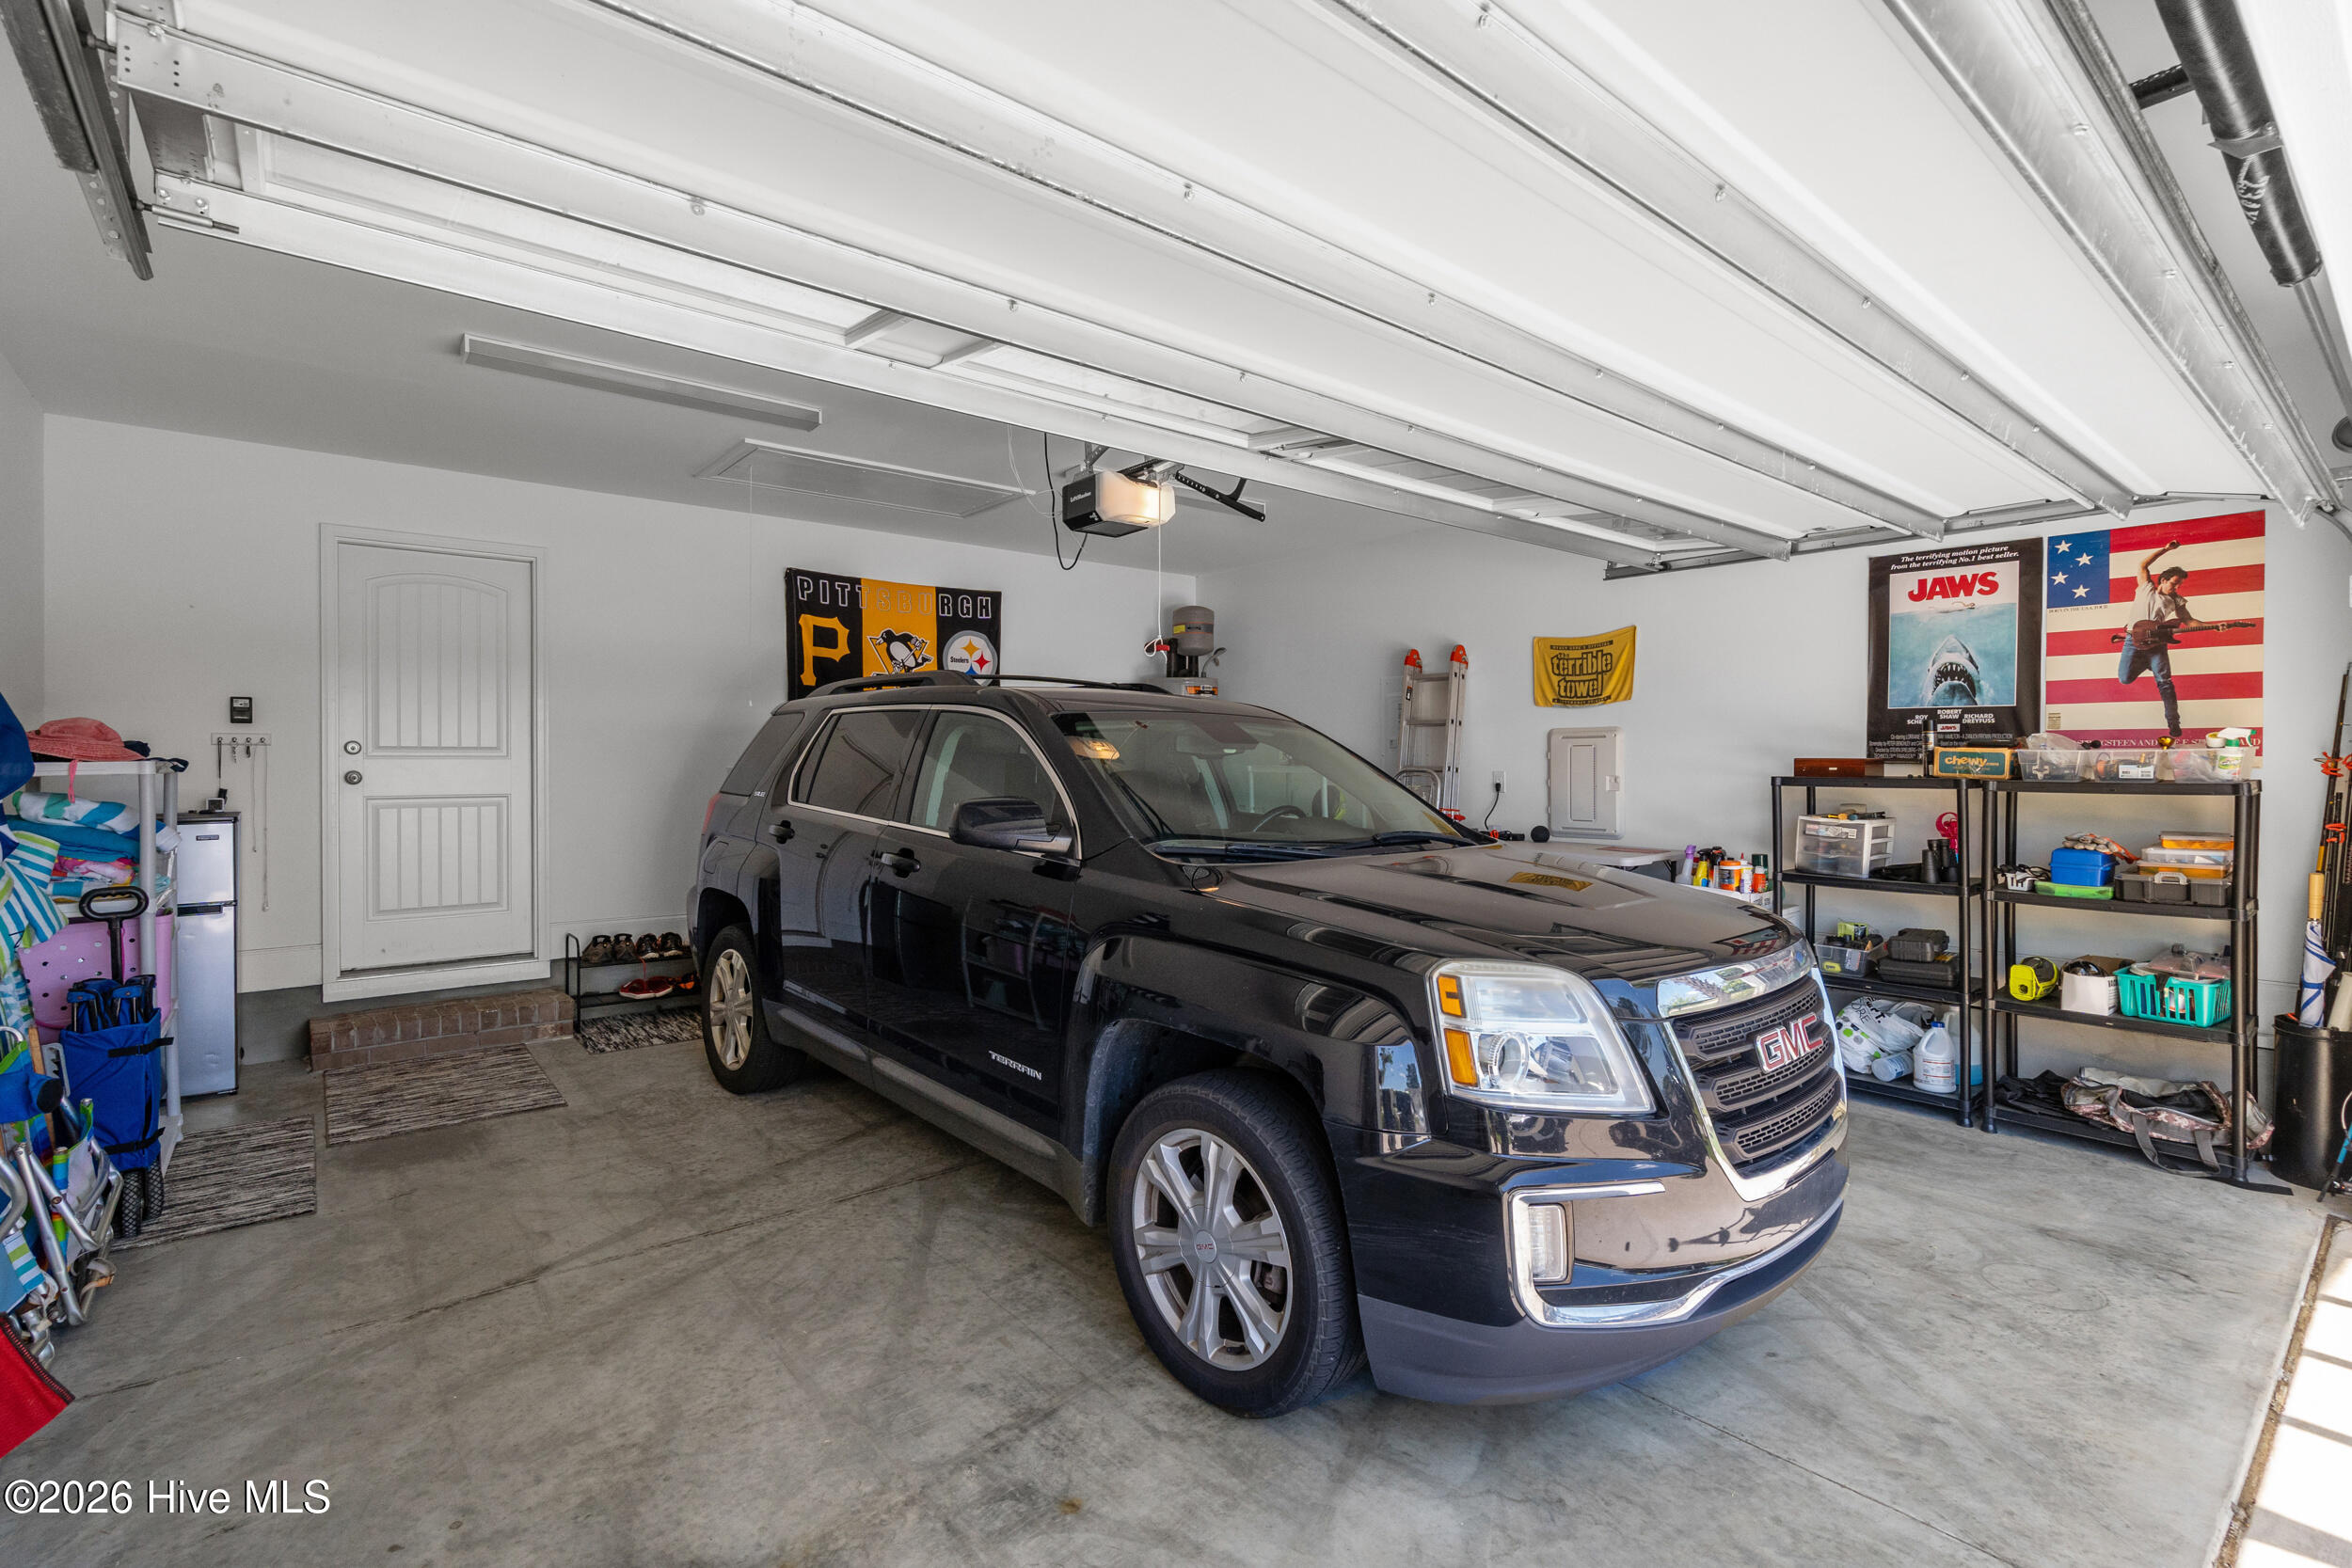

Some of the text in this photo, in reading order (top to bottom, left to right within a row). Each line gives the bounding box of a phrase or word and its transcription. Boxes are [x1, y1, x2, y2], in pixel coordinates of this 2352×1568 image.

[1915, 551, 1951, 561] terrifying
[1951, 548, 1979, 557] motion
[1979, 546, 2010, 555] picture
[1922, 558, 1958, 567] terrifying
[797, 576, 992, 619] PITTSBURGH
[1907, 571, 2000, 602] JAWS
[949, 656, 969, 664] Steelers
[1550, 649, 1613, 676] terrible
[1557, 673, 1604, 699] towel
[1944, 755, 1988, 768] chewy
[1755, 1012, 1824, 1073] GMC
[988, 1050, 1042, 1081] TERRAIN
[1196, 1243, 1215, 1251] GMC
